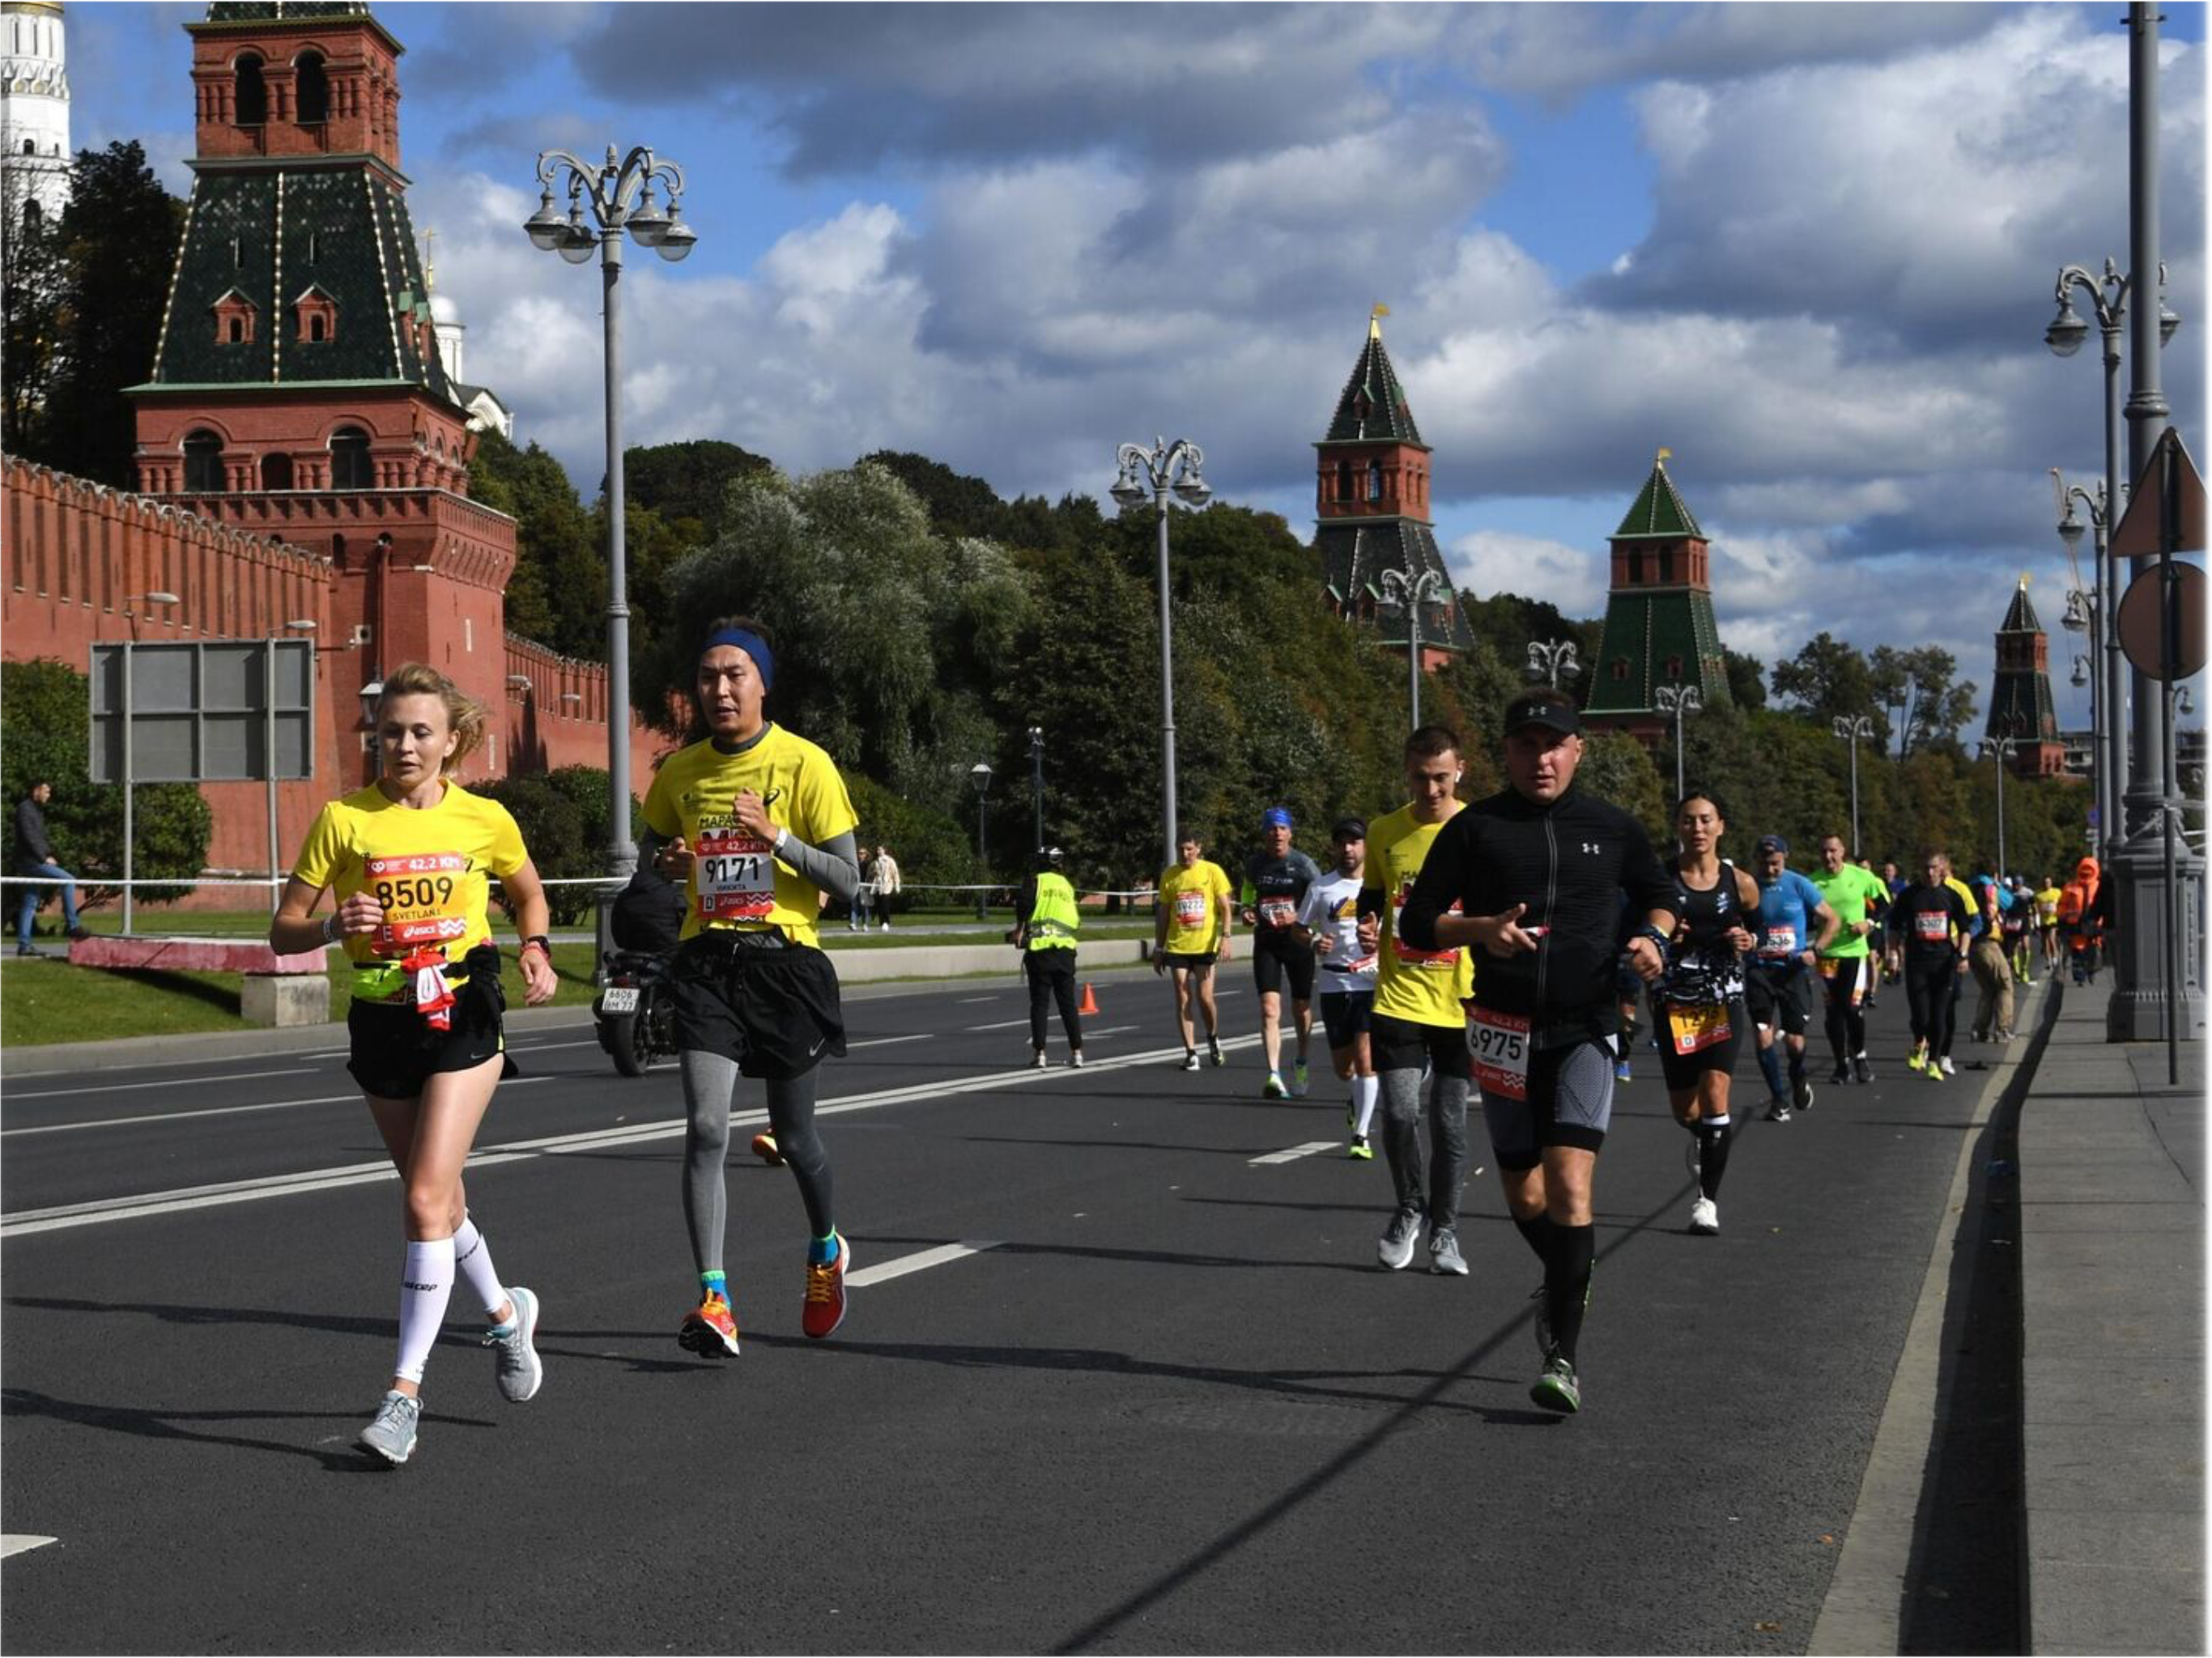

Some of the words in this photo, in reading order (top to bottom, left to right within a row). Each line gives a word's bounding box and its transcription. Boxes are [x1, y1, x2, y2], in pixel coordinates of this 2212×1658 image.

[700, 815, 738, 828] МАРА
[705, 857, 759, 883] 9171
[376, 877, 453, 910] 8509
[1470, 1023, 1522, 1061] 6975
